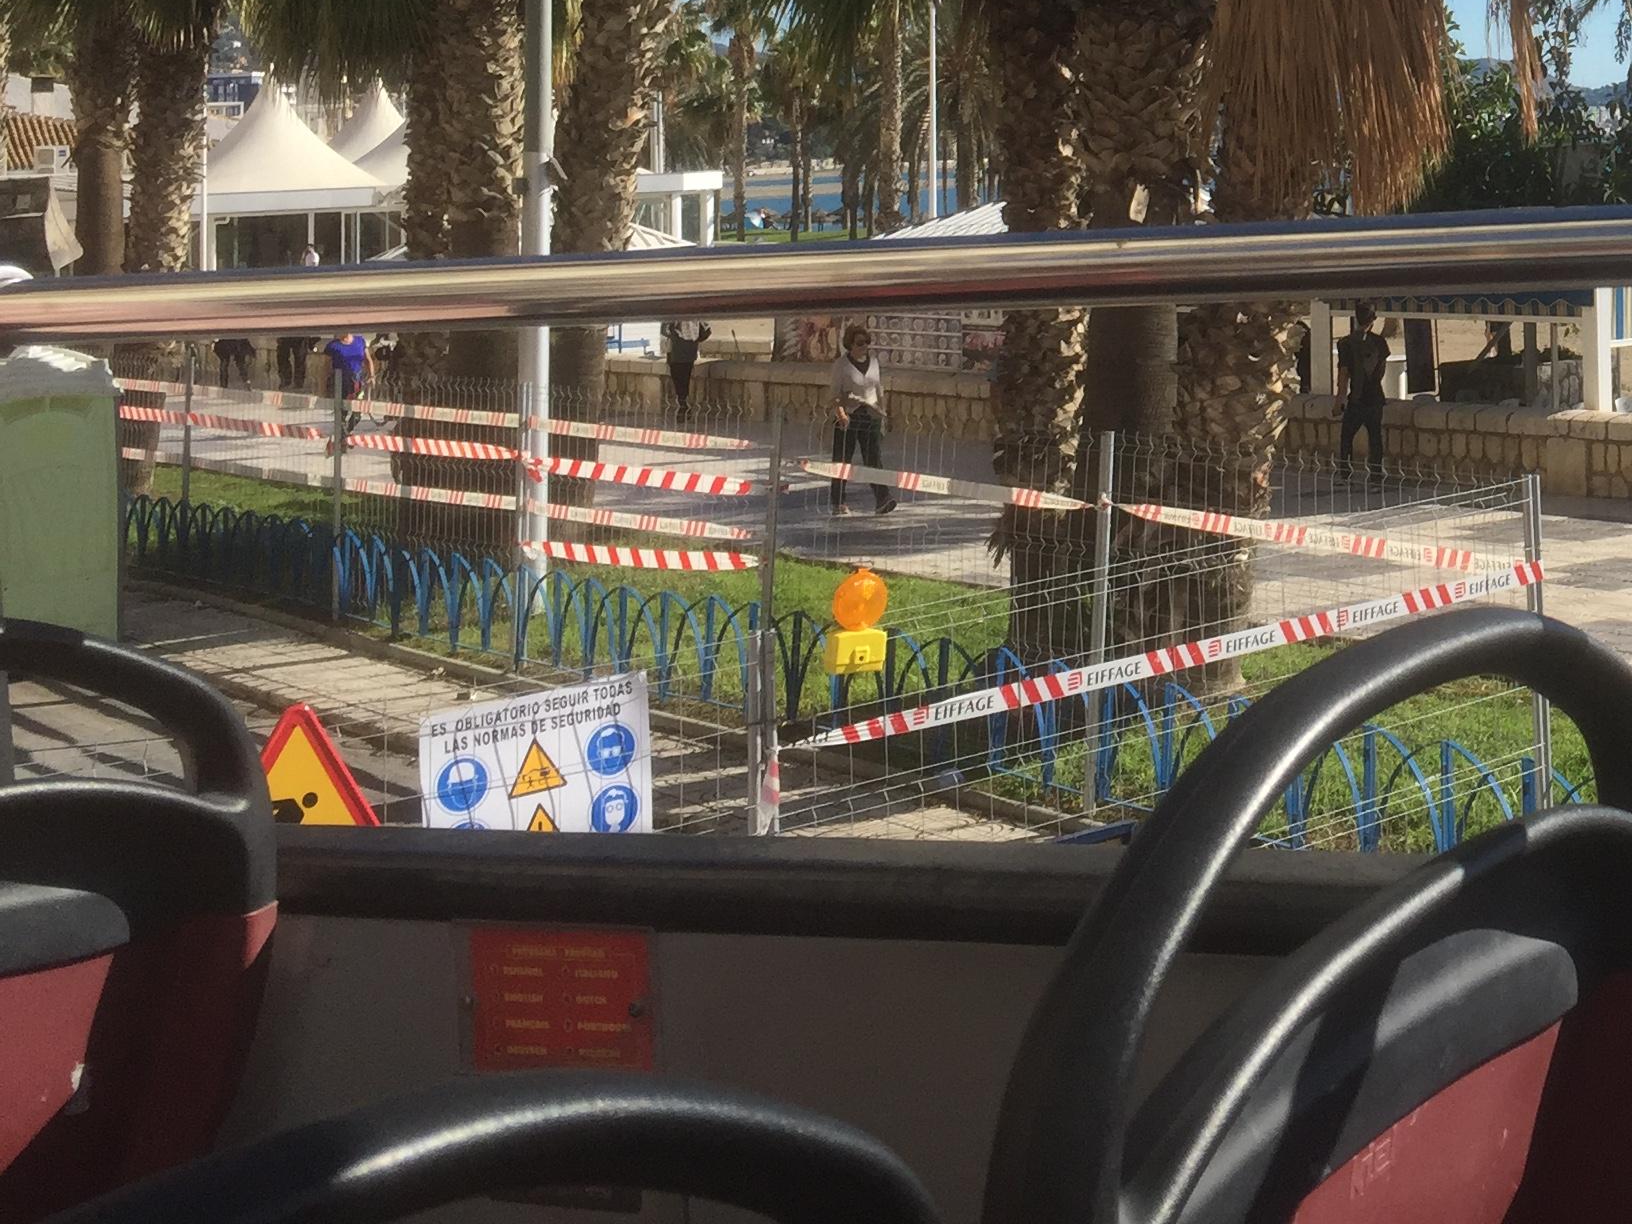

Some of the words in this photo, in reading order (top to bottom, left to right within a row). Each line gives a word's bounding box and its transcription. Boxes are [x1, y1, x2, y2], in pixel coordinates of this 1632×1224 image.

[934, 694, 994, 721] EIFFAGE
[1087, 661, 1142, 686] EIFFAGE
[1226, 631, 1276, 653] EIFFAGE
[1352, 602, 1399, 623] EIFFAGE
[1469, 573, 1511, 595] EIFFAGE
[431, 722, 447, 738] ES
[455, 701, 540, 732] OBLIGATORIO
[544, 690, 589, 713] SEGUIR
[593, 680, 633, 701] TODAS
[444, 736, 468, 754] LAS
[474, 723, 526, 747] NORMAS
[531, 718, 546, 735] DE
[551, 702, 621, 730] SEGURIDAD
